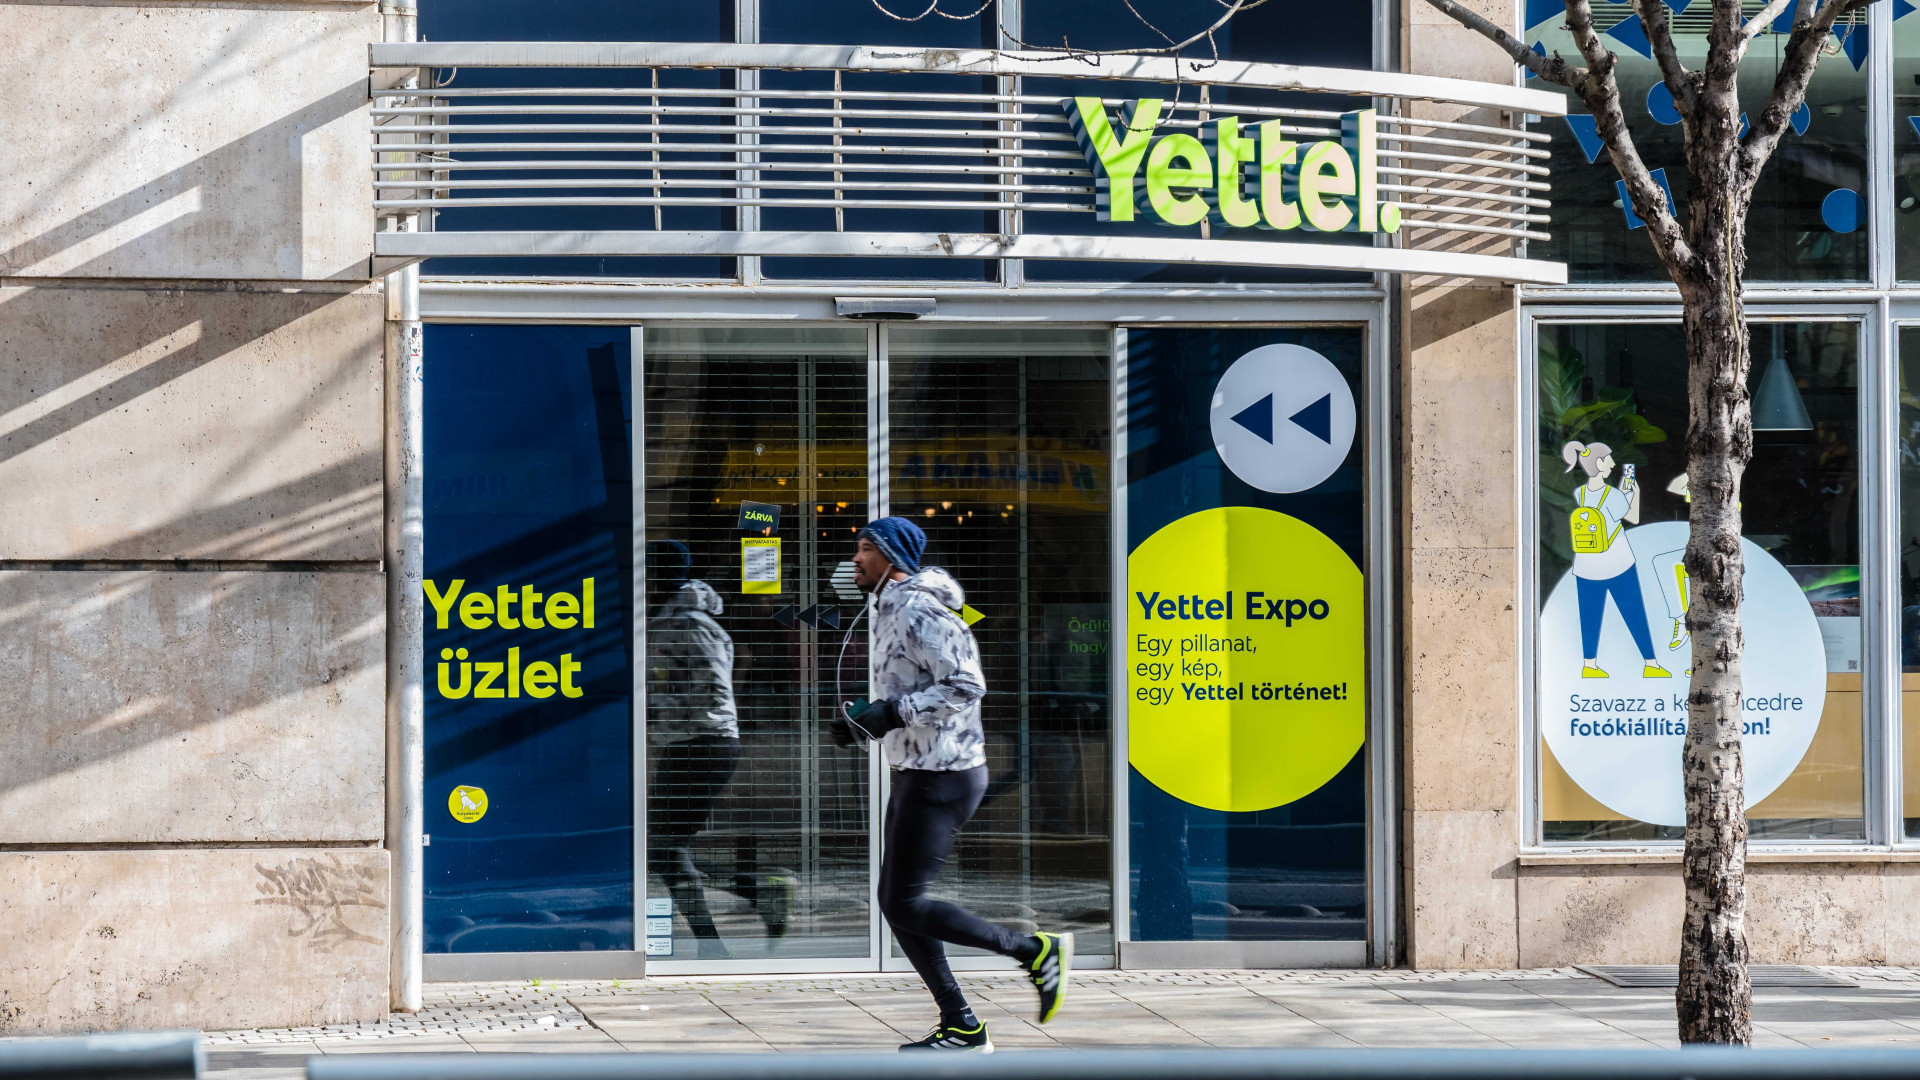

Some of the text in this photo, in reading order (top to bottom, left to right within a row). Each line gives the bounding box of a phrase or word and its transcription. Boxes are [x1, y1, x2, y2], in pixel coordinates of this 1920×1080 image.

[1074, 96, 1401, 234] Yettel.
[744, 511, 774, 523] ZÁRVA
[422, 576, 595, 630] Yettel
[1136, 590, 1330, 627] Yettel Expo
[1137, 634, 1257, 656] Egy pillanat,
[437, 646, 584, 699] üzlet
[1136, 662, 1174, 681] egy
[1181, 658, 1222, 680] kép,
[1136, 682, 1347, 705] egy Yettel történet!
[1570, 694, 1646, 712] Szavazz
[1654, 698, 1665, 712] a
